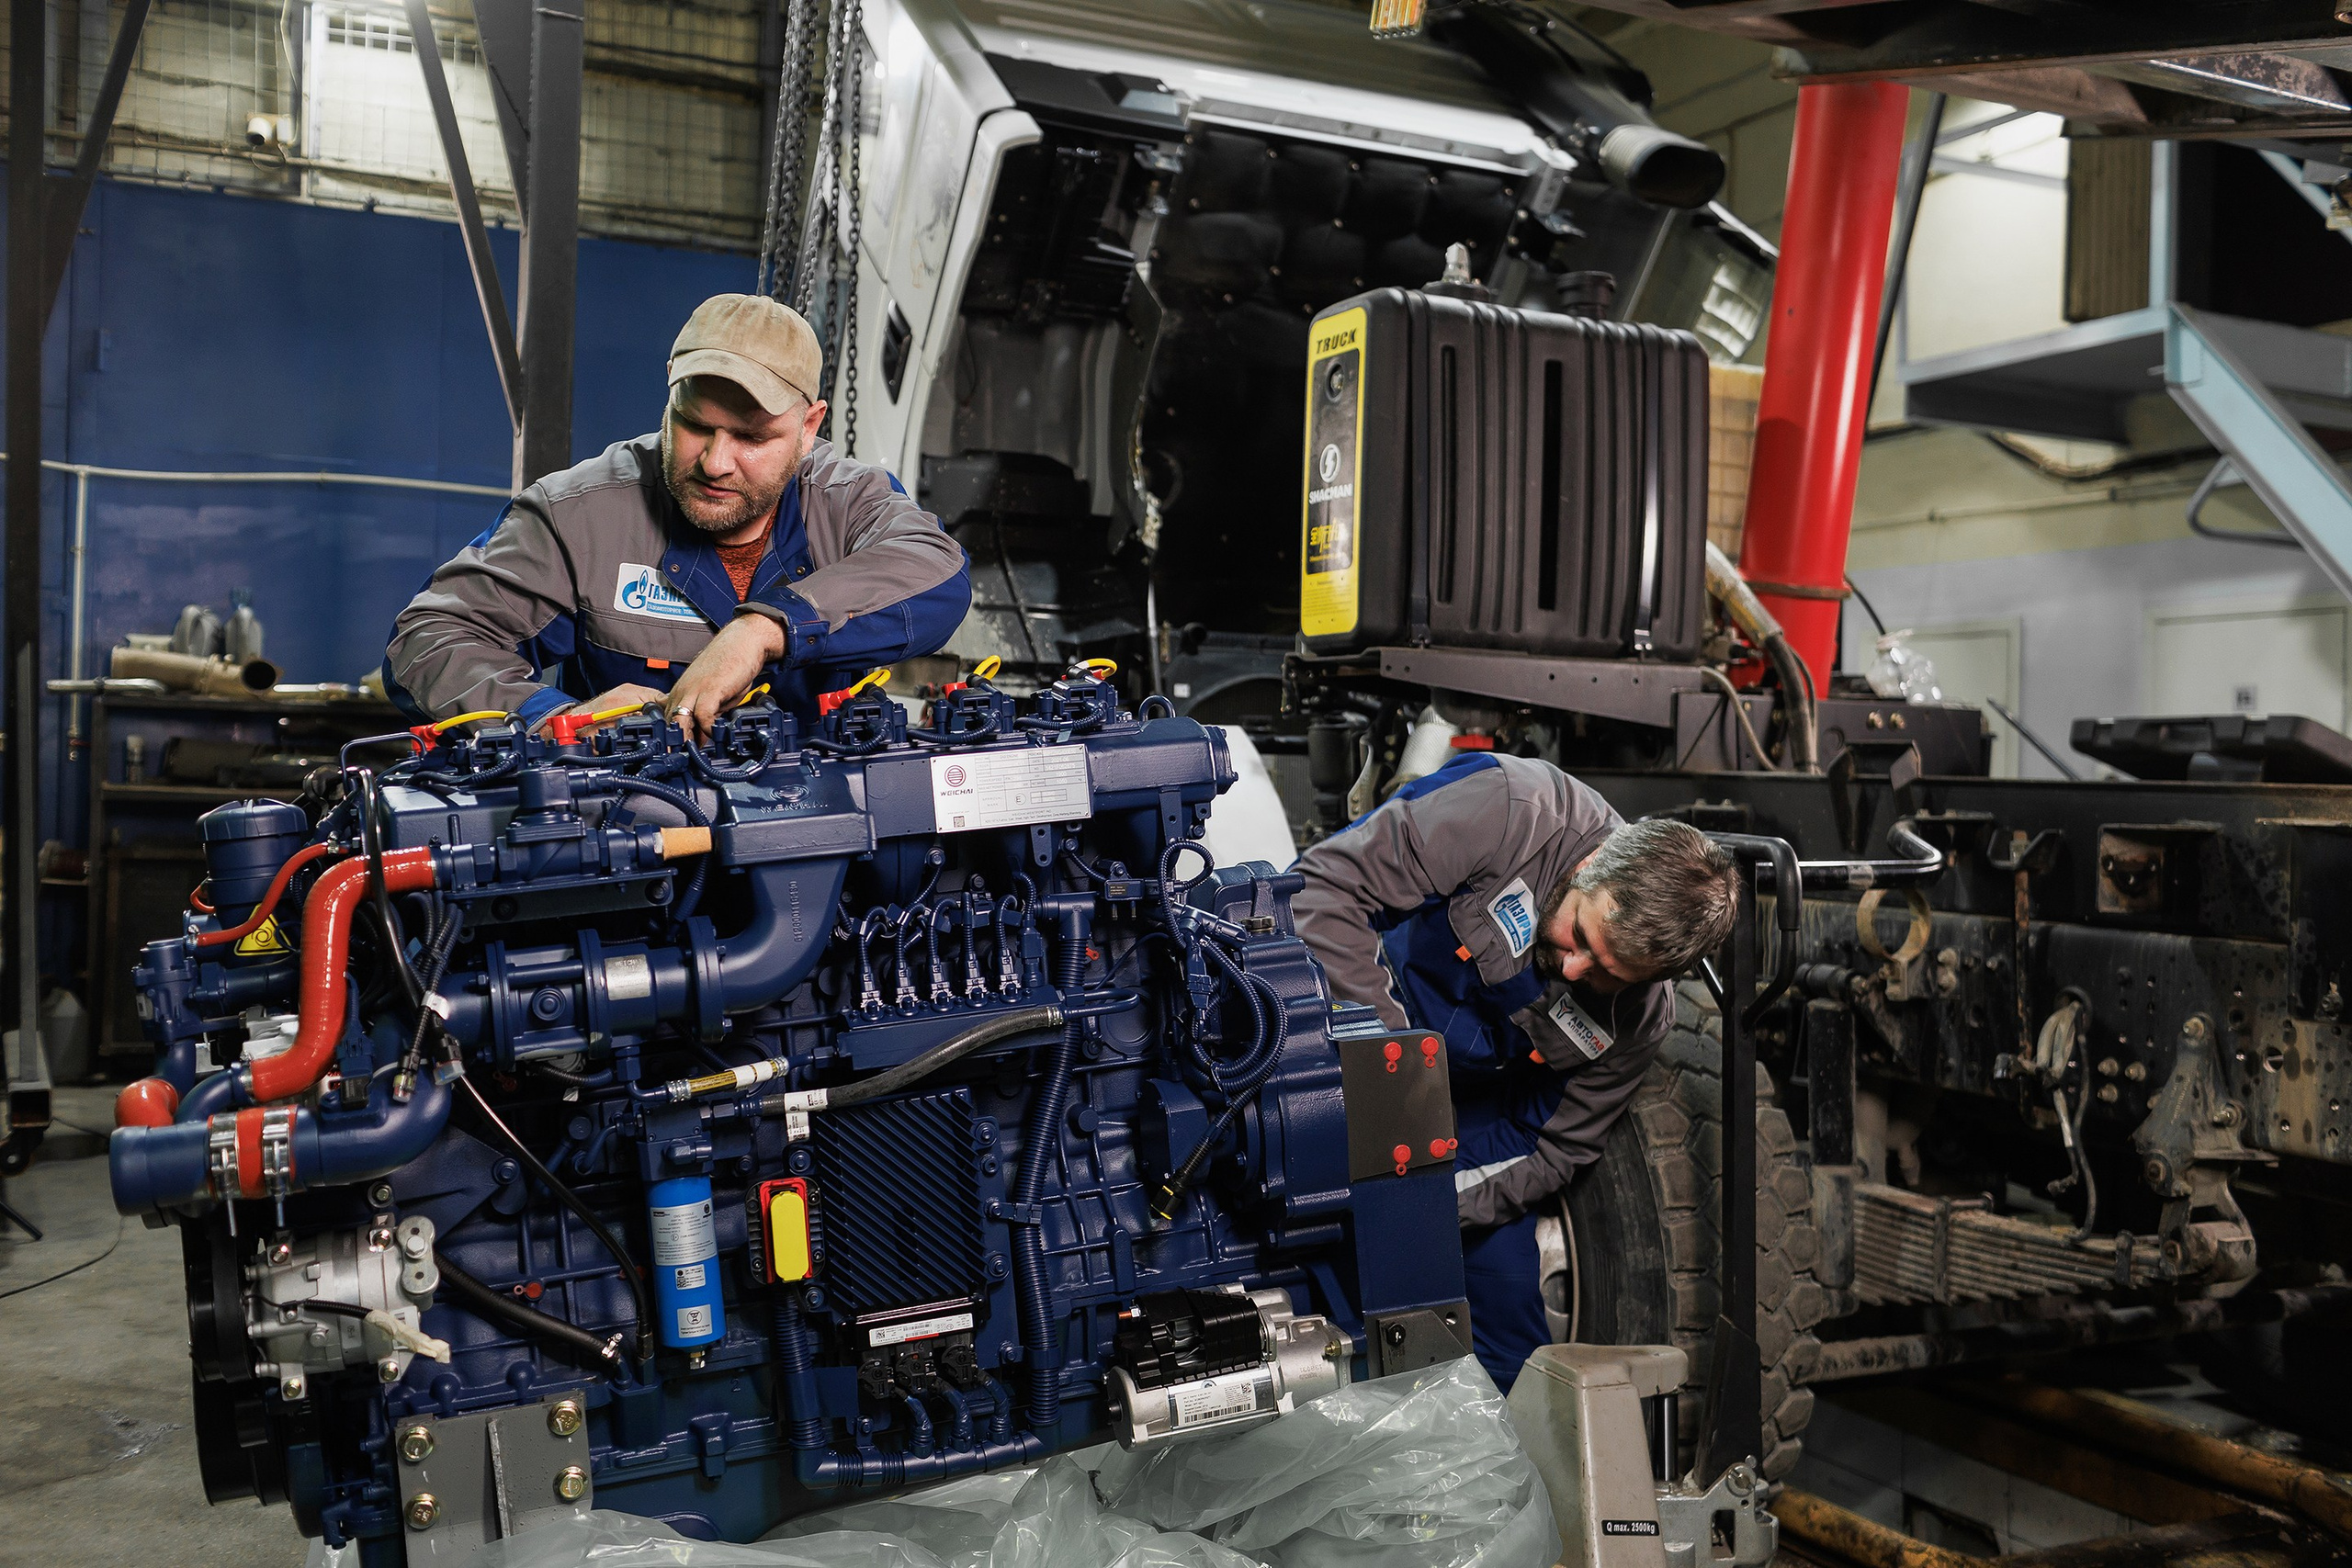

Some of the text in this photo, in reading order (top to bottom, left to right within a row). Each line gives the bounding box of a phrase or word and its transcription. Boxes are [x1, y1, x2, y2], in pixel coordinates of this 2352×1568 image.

[1316, 327, 1357, 355] TRUCK
[1308, 483, 1353, 505] SHACMAN
[940, 788, 974, 796] WEICHAI
[1606, 1521, 1656, 1535] Q max. 2500kg
